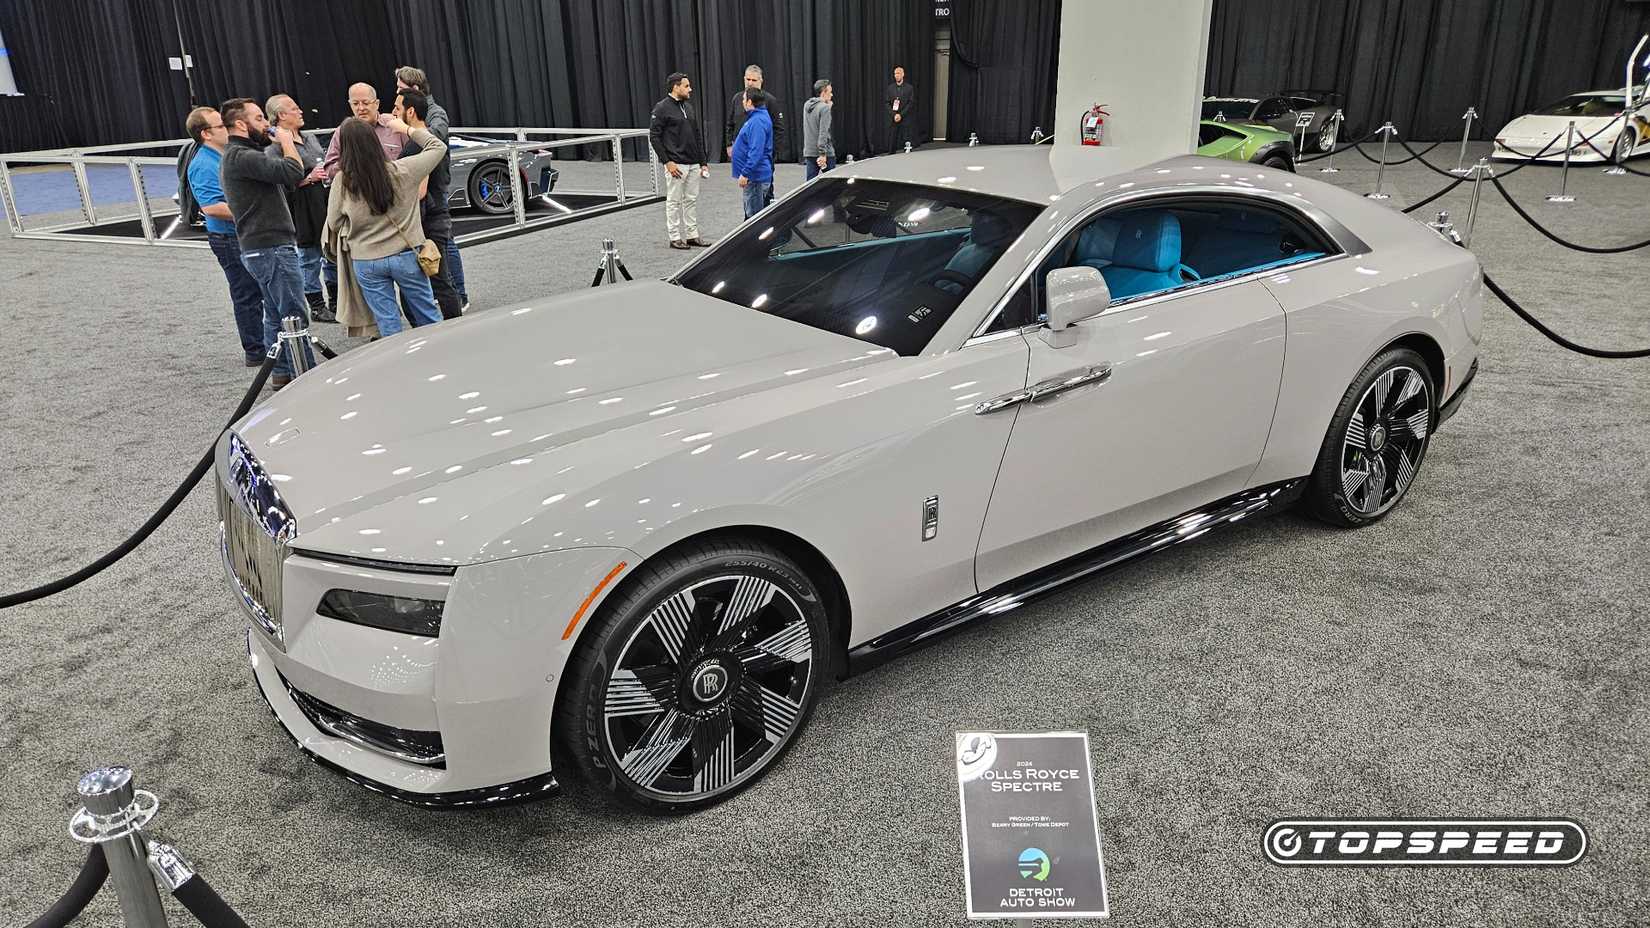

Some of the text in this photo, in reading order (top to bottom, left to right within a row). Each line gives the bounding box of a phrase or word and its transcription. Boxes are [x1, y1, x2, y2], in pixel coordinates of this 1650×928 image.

[980, 768, 1080, 780] OLLS ROYCE
[991, 781, 1063, 792] SPECTRE
[1009, 888, 1064, 897] DETROIT
[1000, 897, 1076, 907] AUTO SHOW
